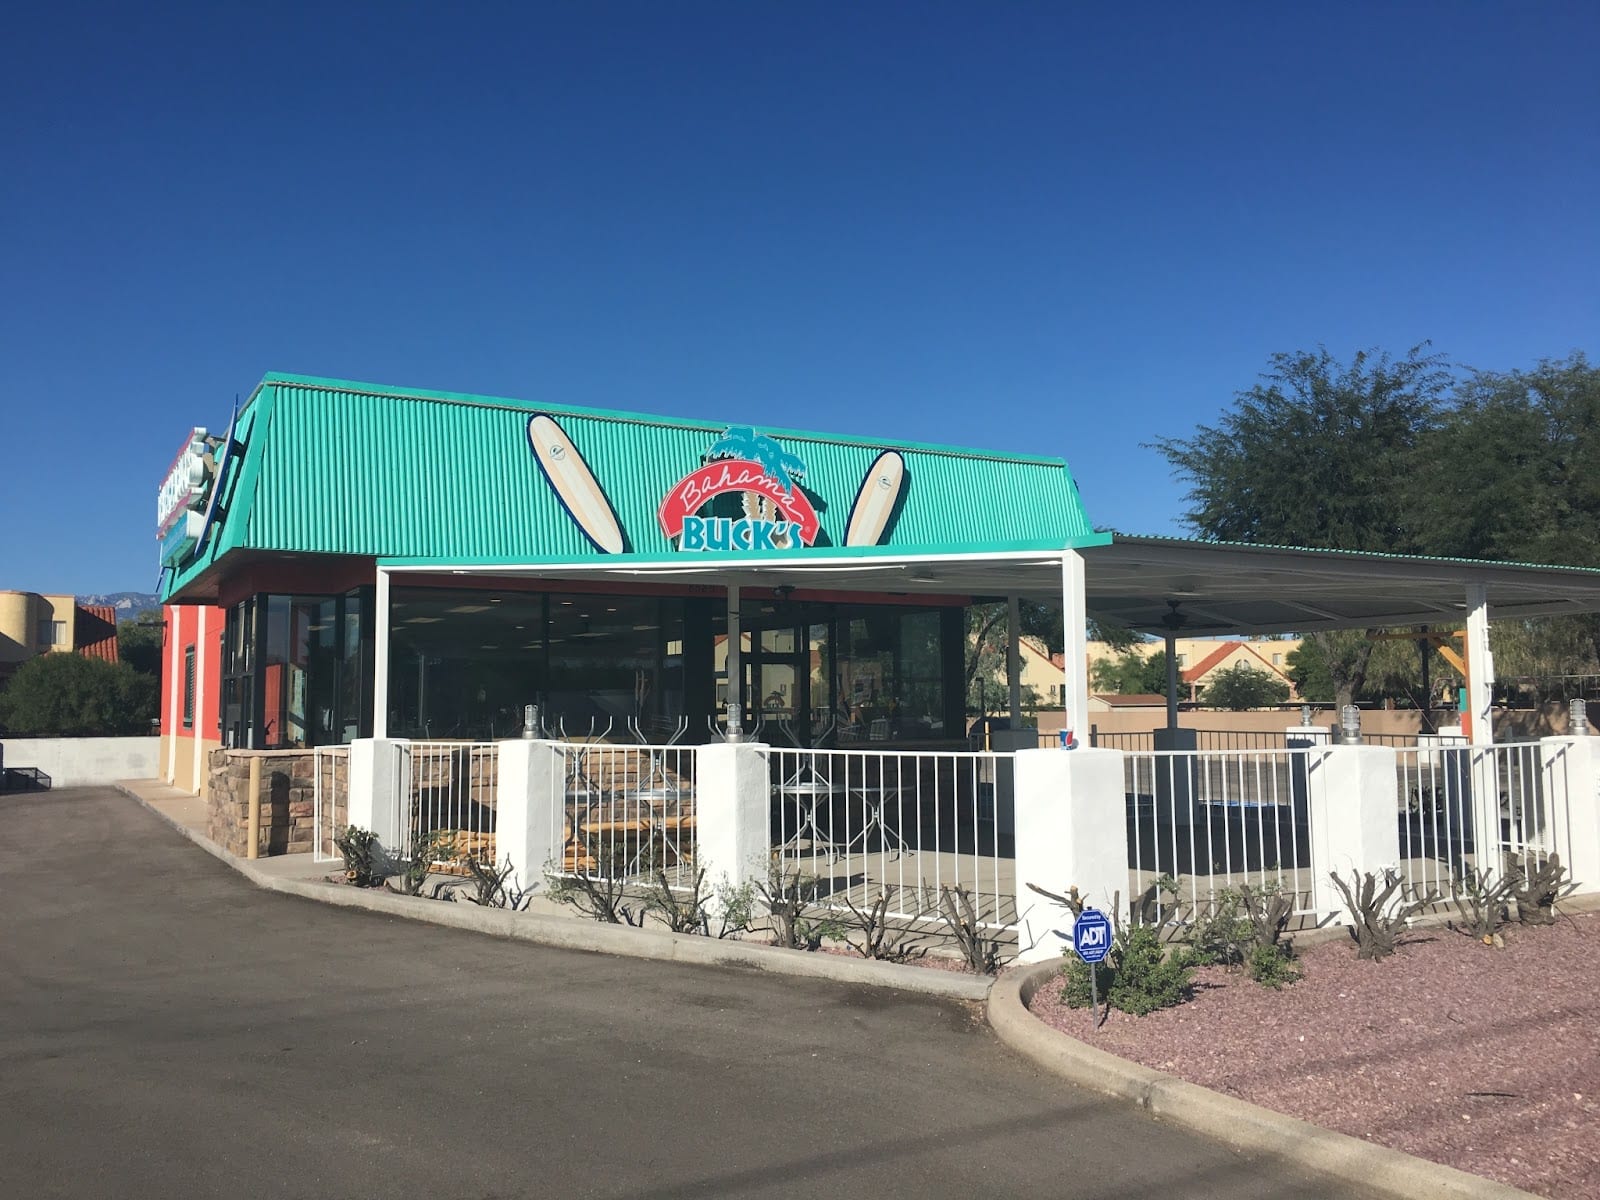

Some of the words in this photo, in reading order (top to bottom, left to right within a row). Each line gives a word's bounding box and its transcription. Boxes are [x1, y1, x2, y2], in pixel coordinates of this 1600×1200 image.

[680, 465, 804, 522] Bahama
[682, 516, 804, 551] BUCK'S
[1080, 927, 1105, 946] ADT
